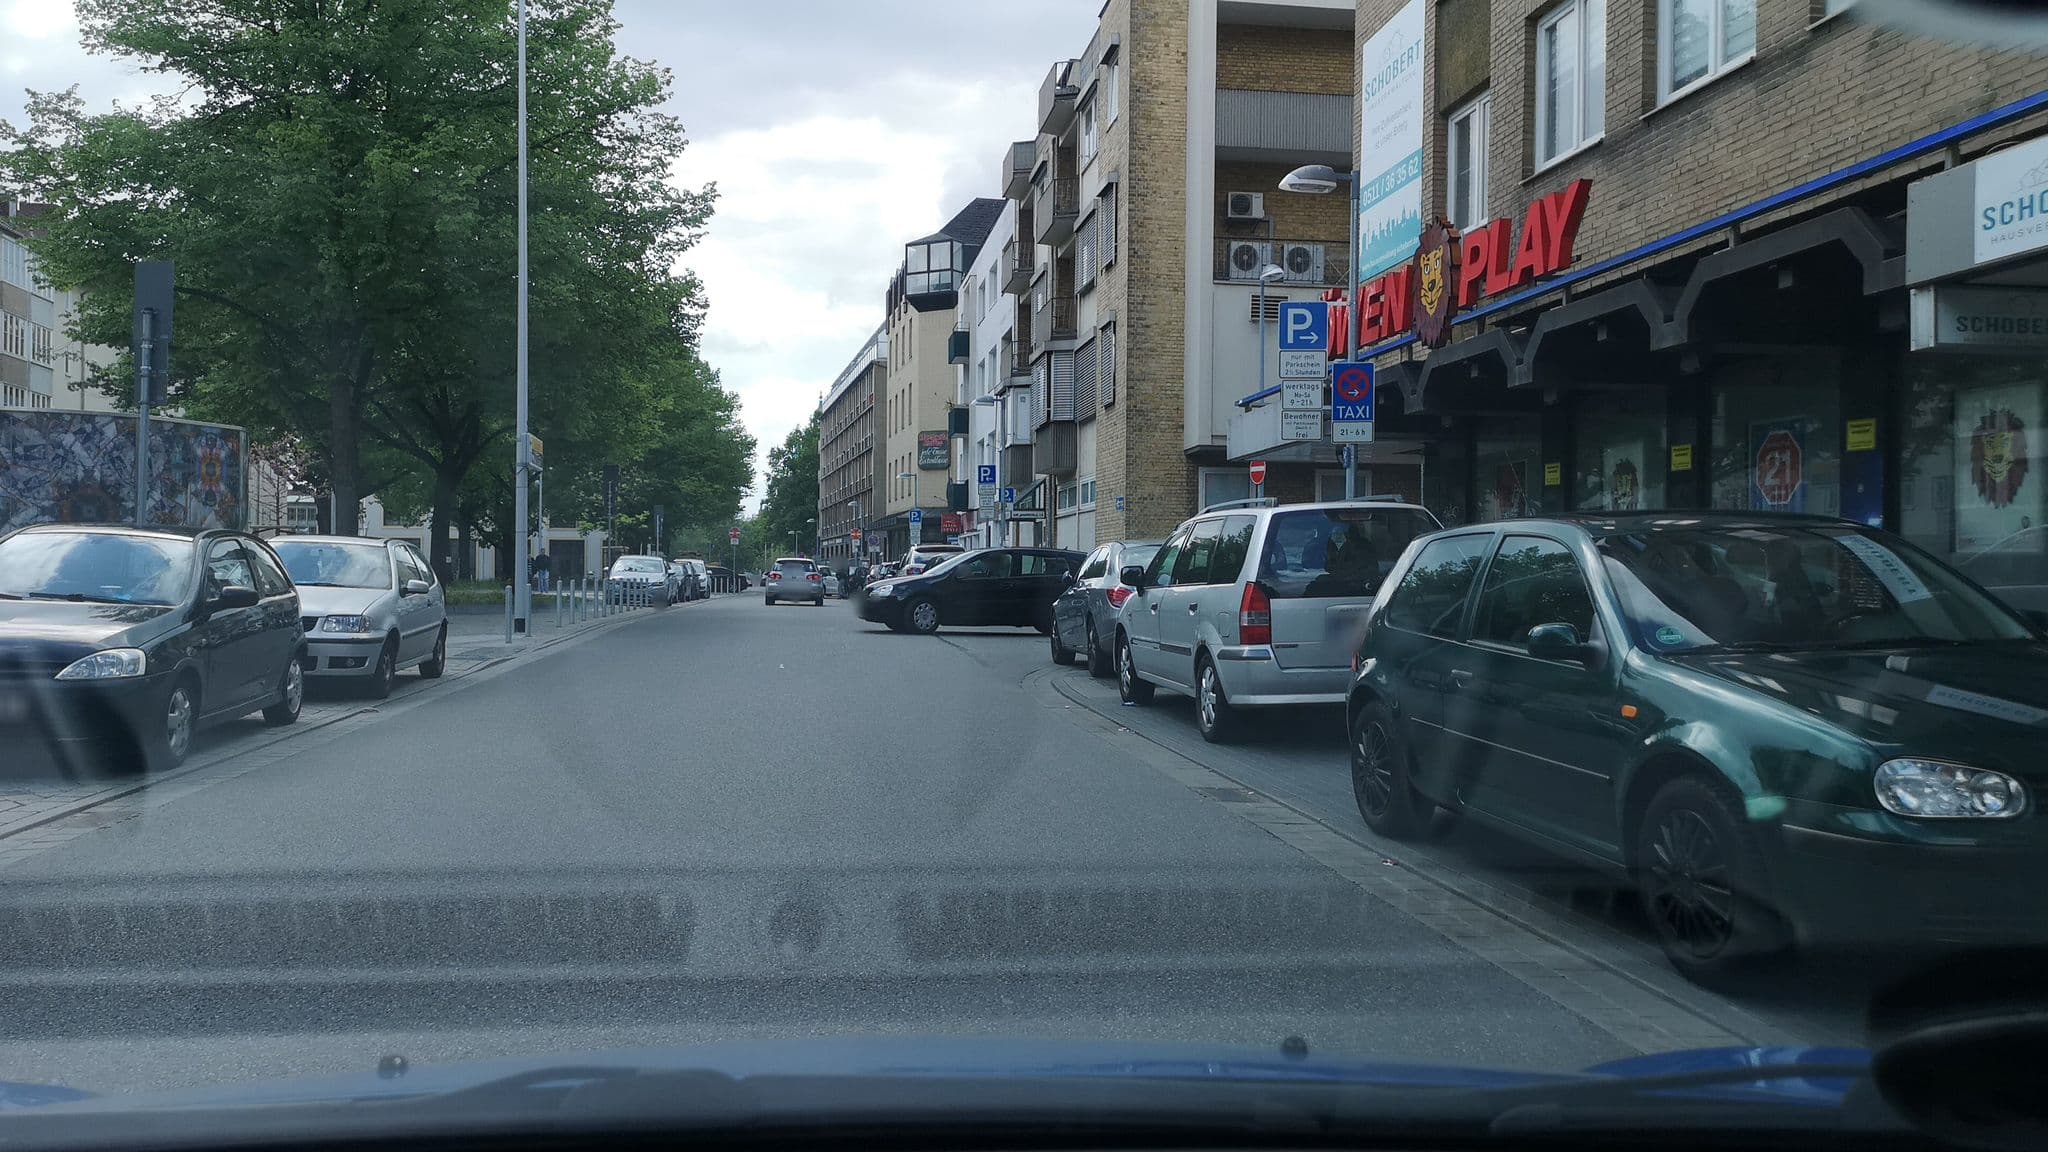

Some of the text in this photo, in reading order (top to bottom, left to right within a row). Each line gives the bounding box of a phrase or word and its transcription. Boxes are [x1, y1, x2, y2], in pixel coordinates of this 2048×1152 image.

[1365, 39, 1421, 102] SCHOBERT
[1363, 182, 1379, 207] 0511
[1385, 173, 1395, 191] 36
[1396, 164, 1406, 184] 35
[1408, 156, 1419, 176] 62
[1458, 178, 1593, 307] PLAY
[1287, 308, 1312, 344] P
[1304, 353, 1315, 361] mit
[1285, 383, 1320, 391] werktags
[1283, 412, 1320, 420] Bewohner
[1336, 405, 1370, 419] TAXI
[981, 467, 991, 482] P
[911, 511, 919, 521] P
